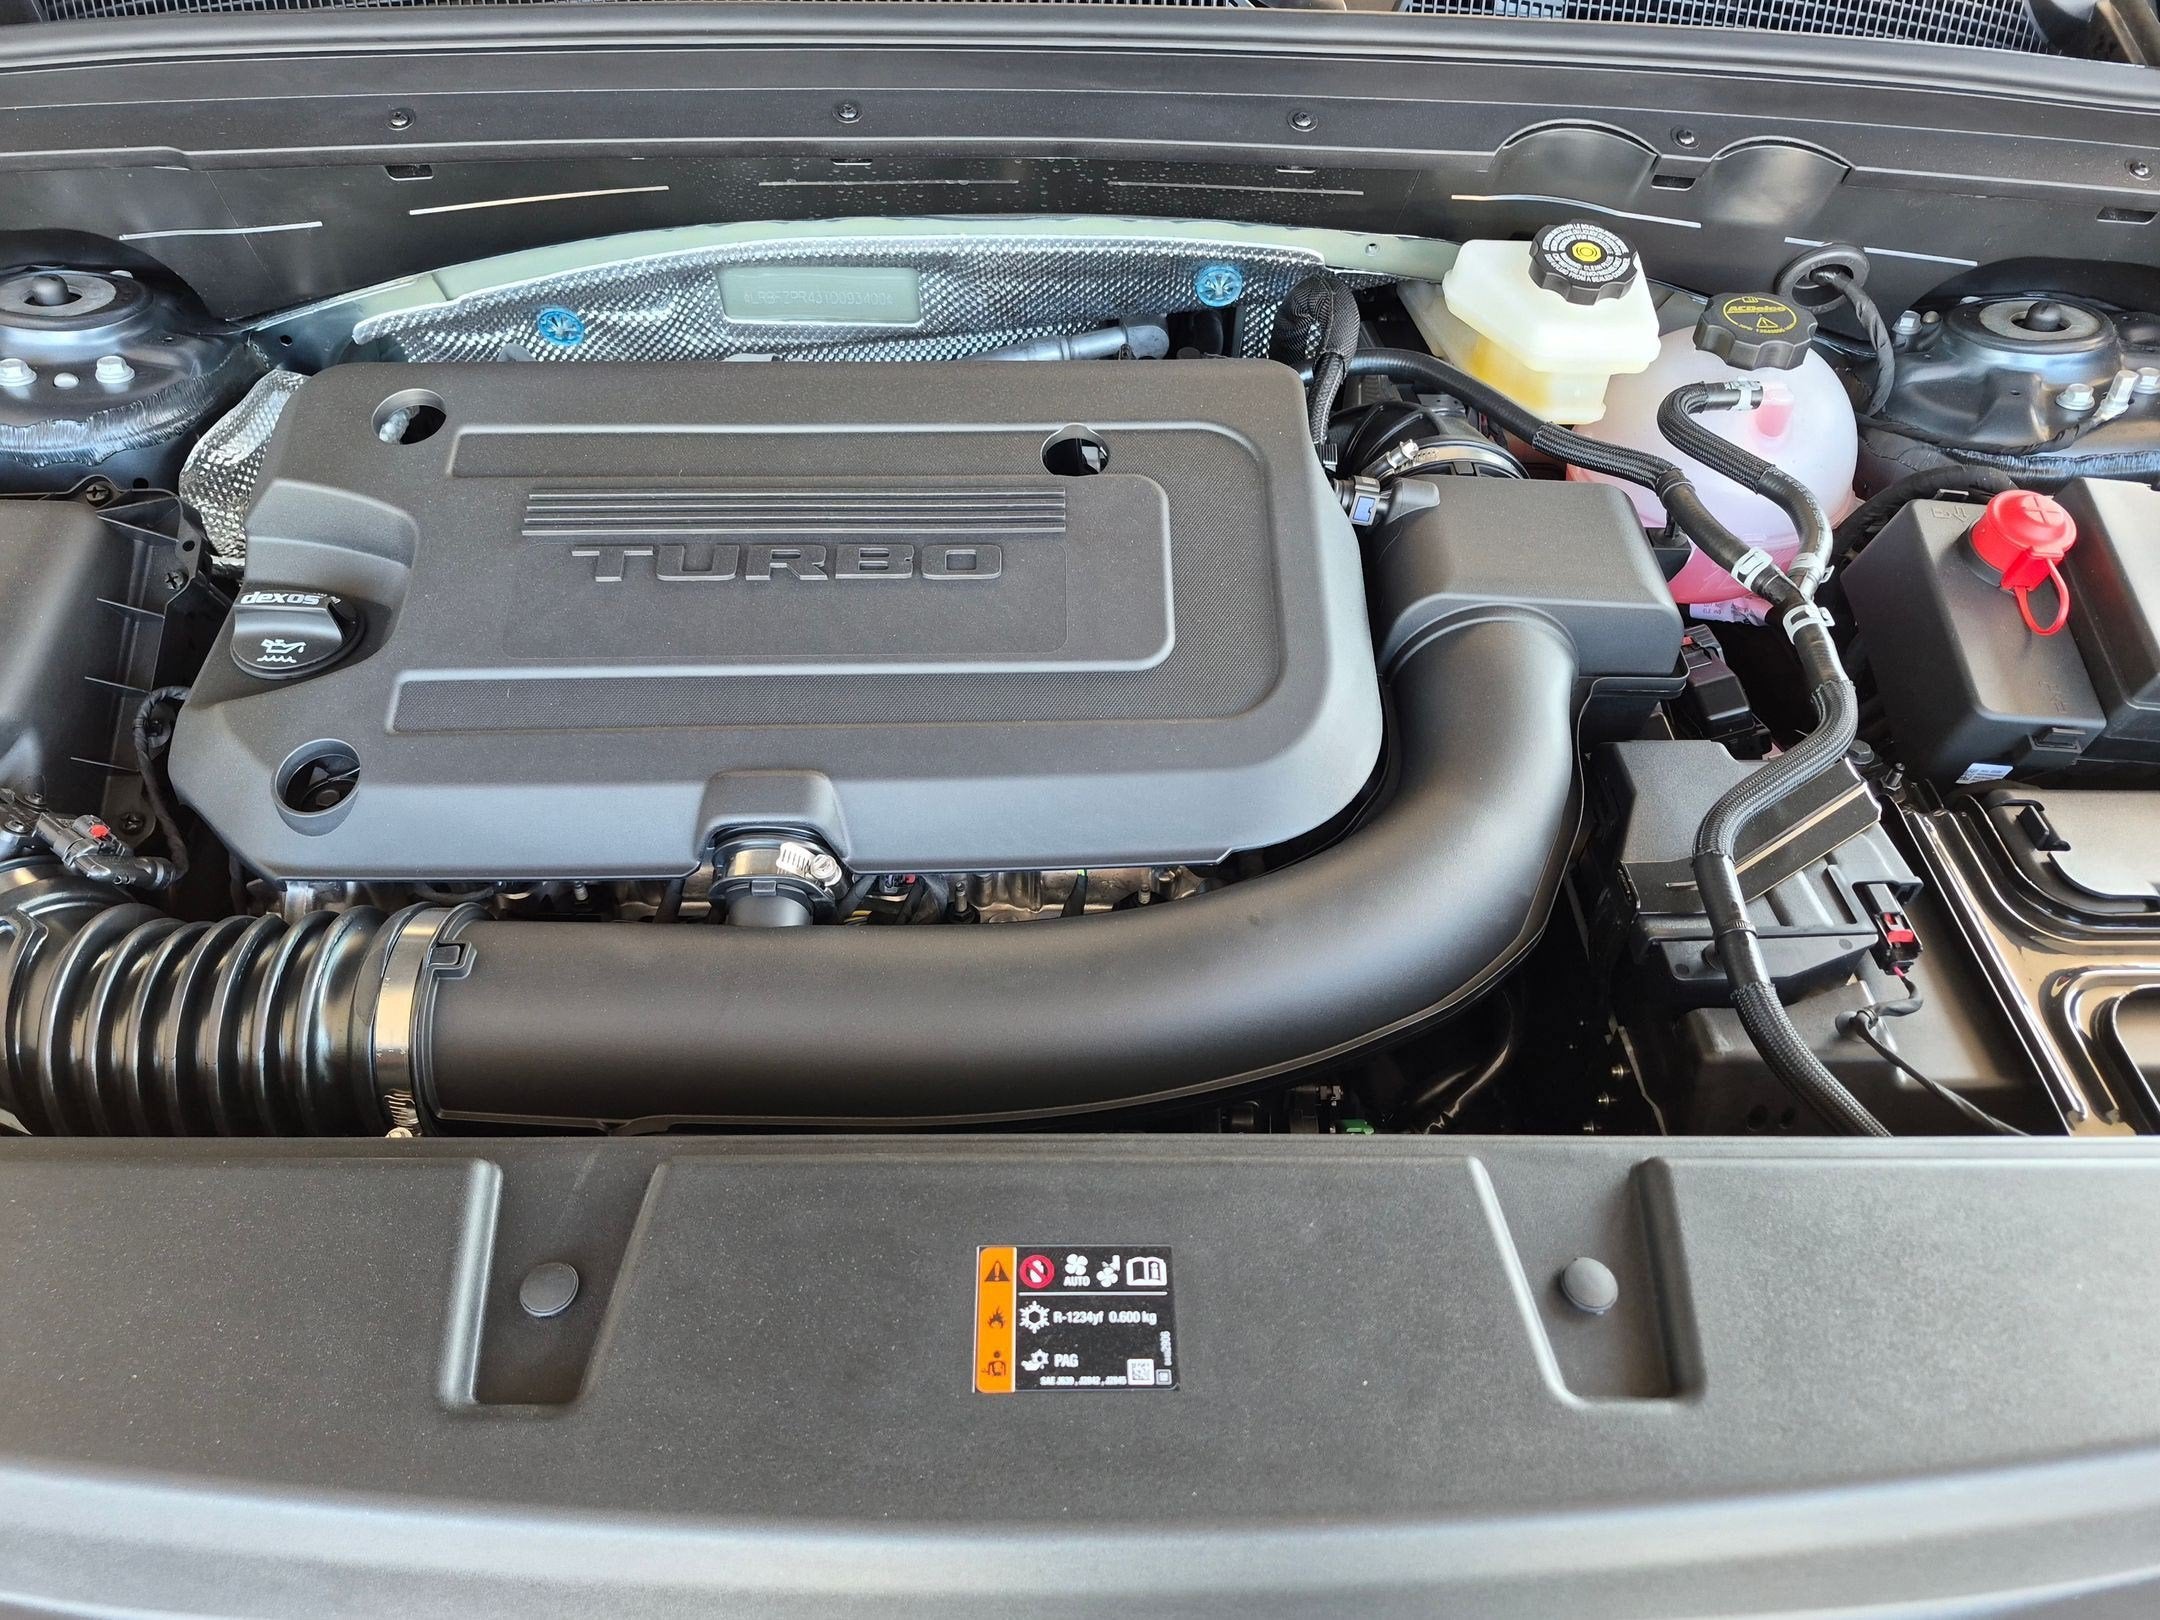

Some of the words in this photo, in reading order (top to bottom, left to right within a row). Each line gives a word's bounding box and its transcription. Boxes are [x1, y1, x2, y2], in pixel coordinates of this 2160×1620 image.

[1726, 305, 1786, 314] ACDelco
[571, 543, 1002, 583] TURBO
[240, 591, 321, 605] dexos
[1063, 1275, 1090, 1287] AUTO
[1052, 1311, 1105, 1325] R-1234yf
[1108, 1311, 1140, 1324] 0.600
[1142, 1311, 1158, 1326] kg
[1054, 1353, 1079, 1368] PAG
